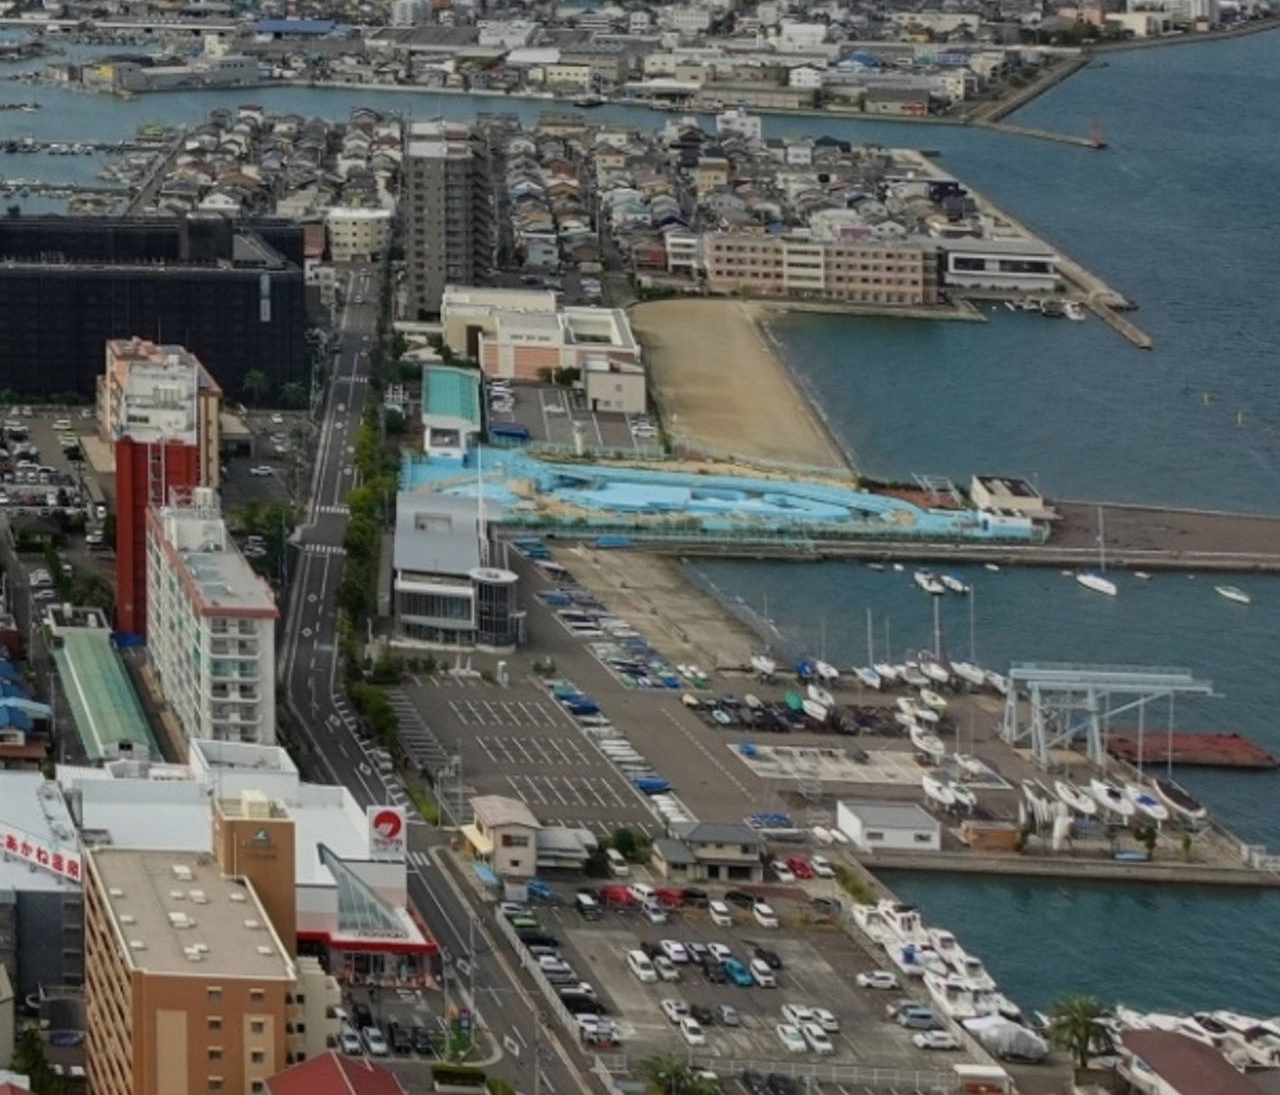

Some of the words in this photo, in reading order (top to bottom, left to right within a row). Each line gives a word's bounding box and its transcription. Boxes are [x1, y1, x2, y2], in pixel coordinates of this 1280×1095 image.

[6, 834, 79, 878] あかね温泉
